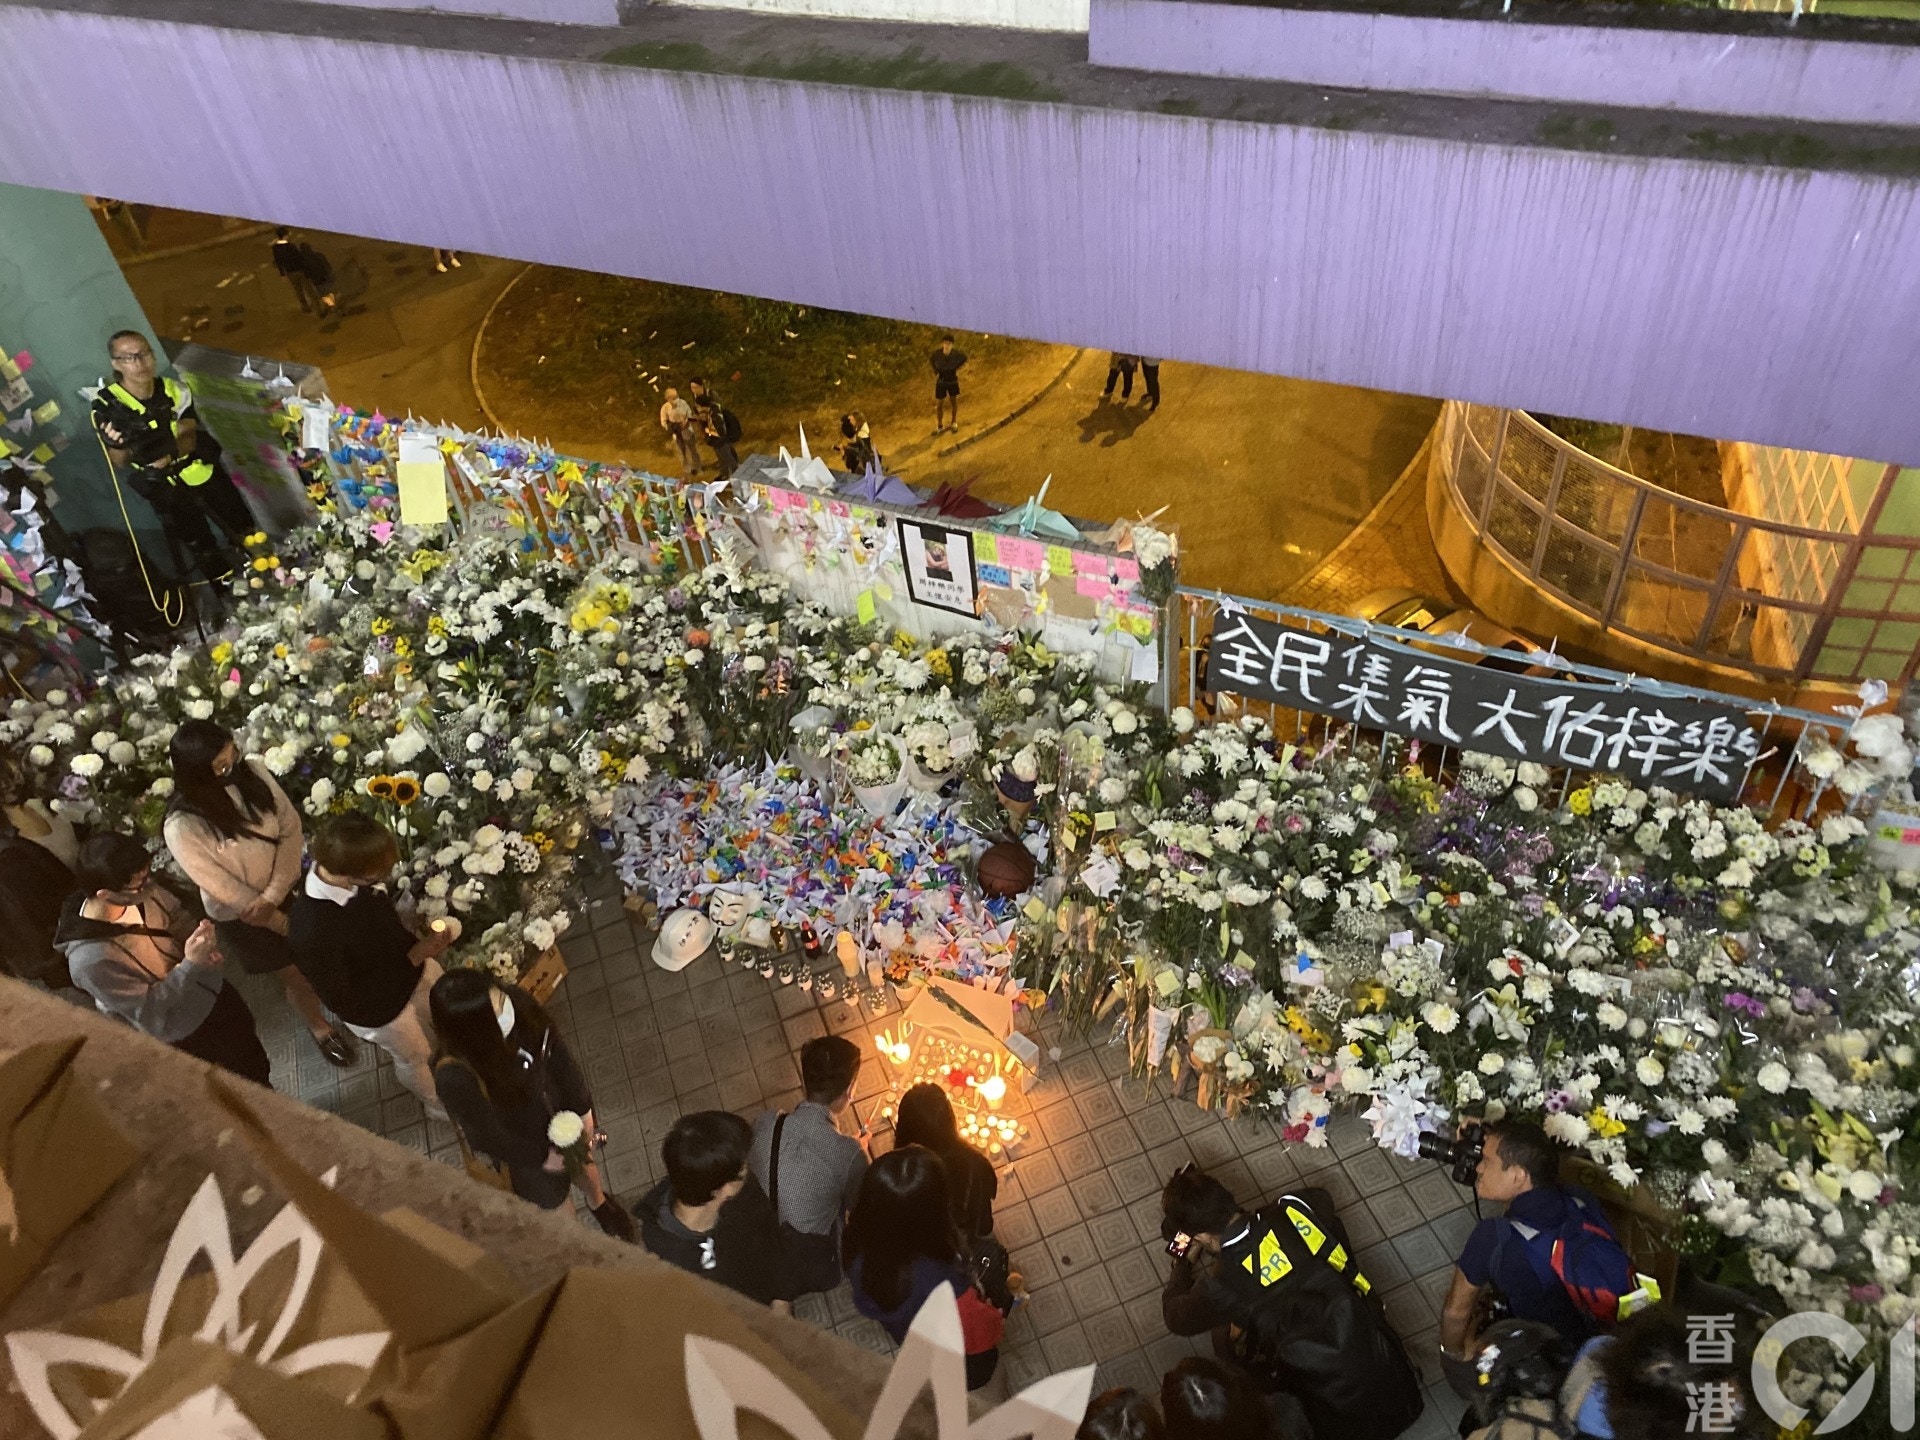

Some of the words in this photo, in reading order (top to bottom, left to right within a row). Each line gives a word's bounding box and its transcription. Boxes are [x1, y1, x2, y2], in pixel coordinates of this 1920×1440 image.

[1214, 616, 1462, 743] 全民集氣
[1471, 689, 1759, 785] 大佑梓樂
